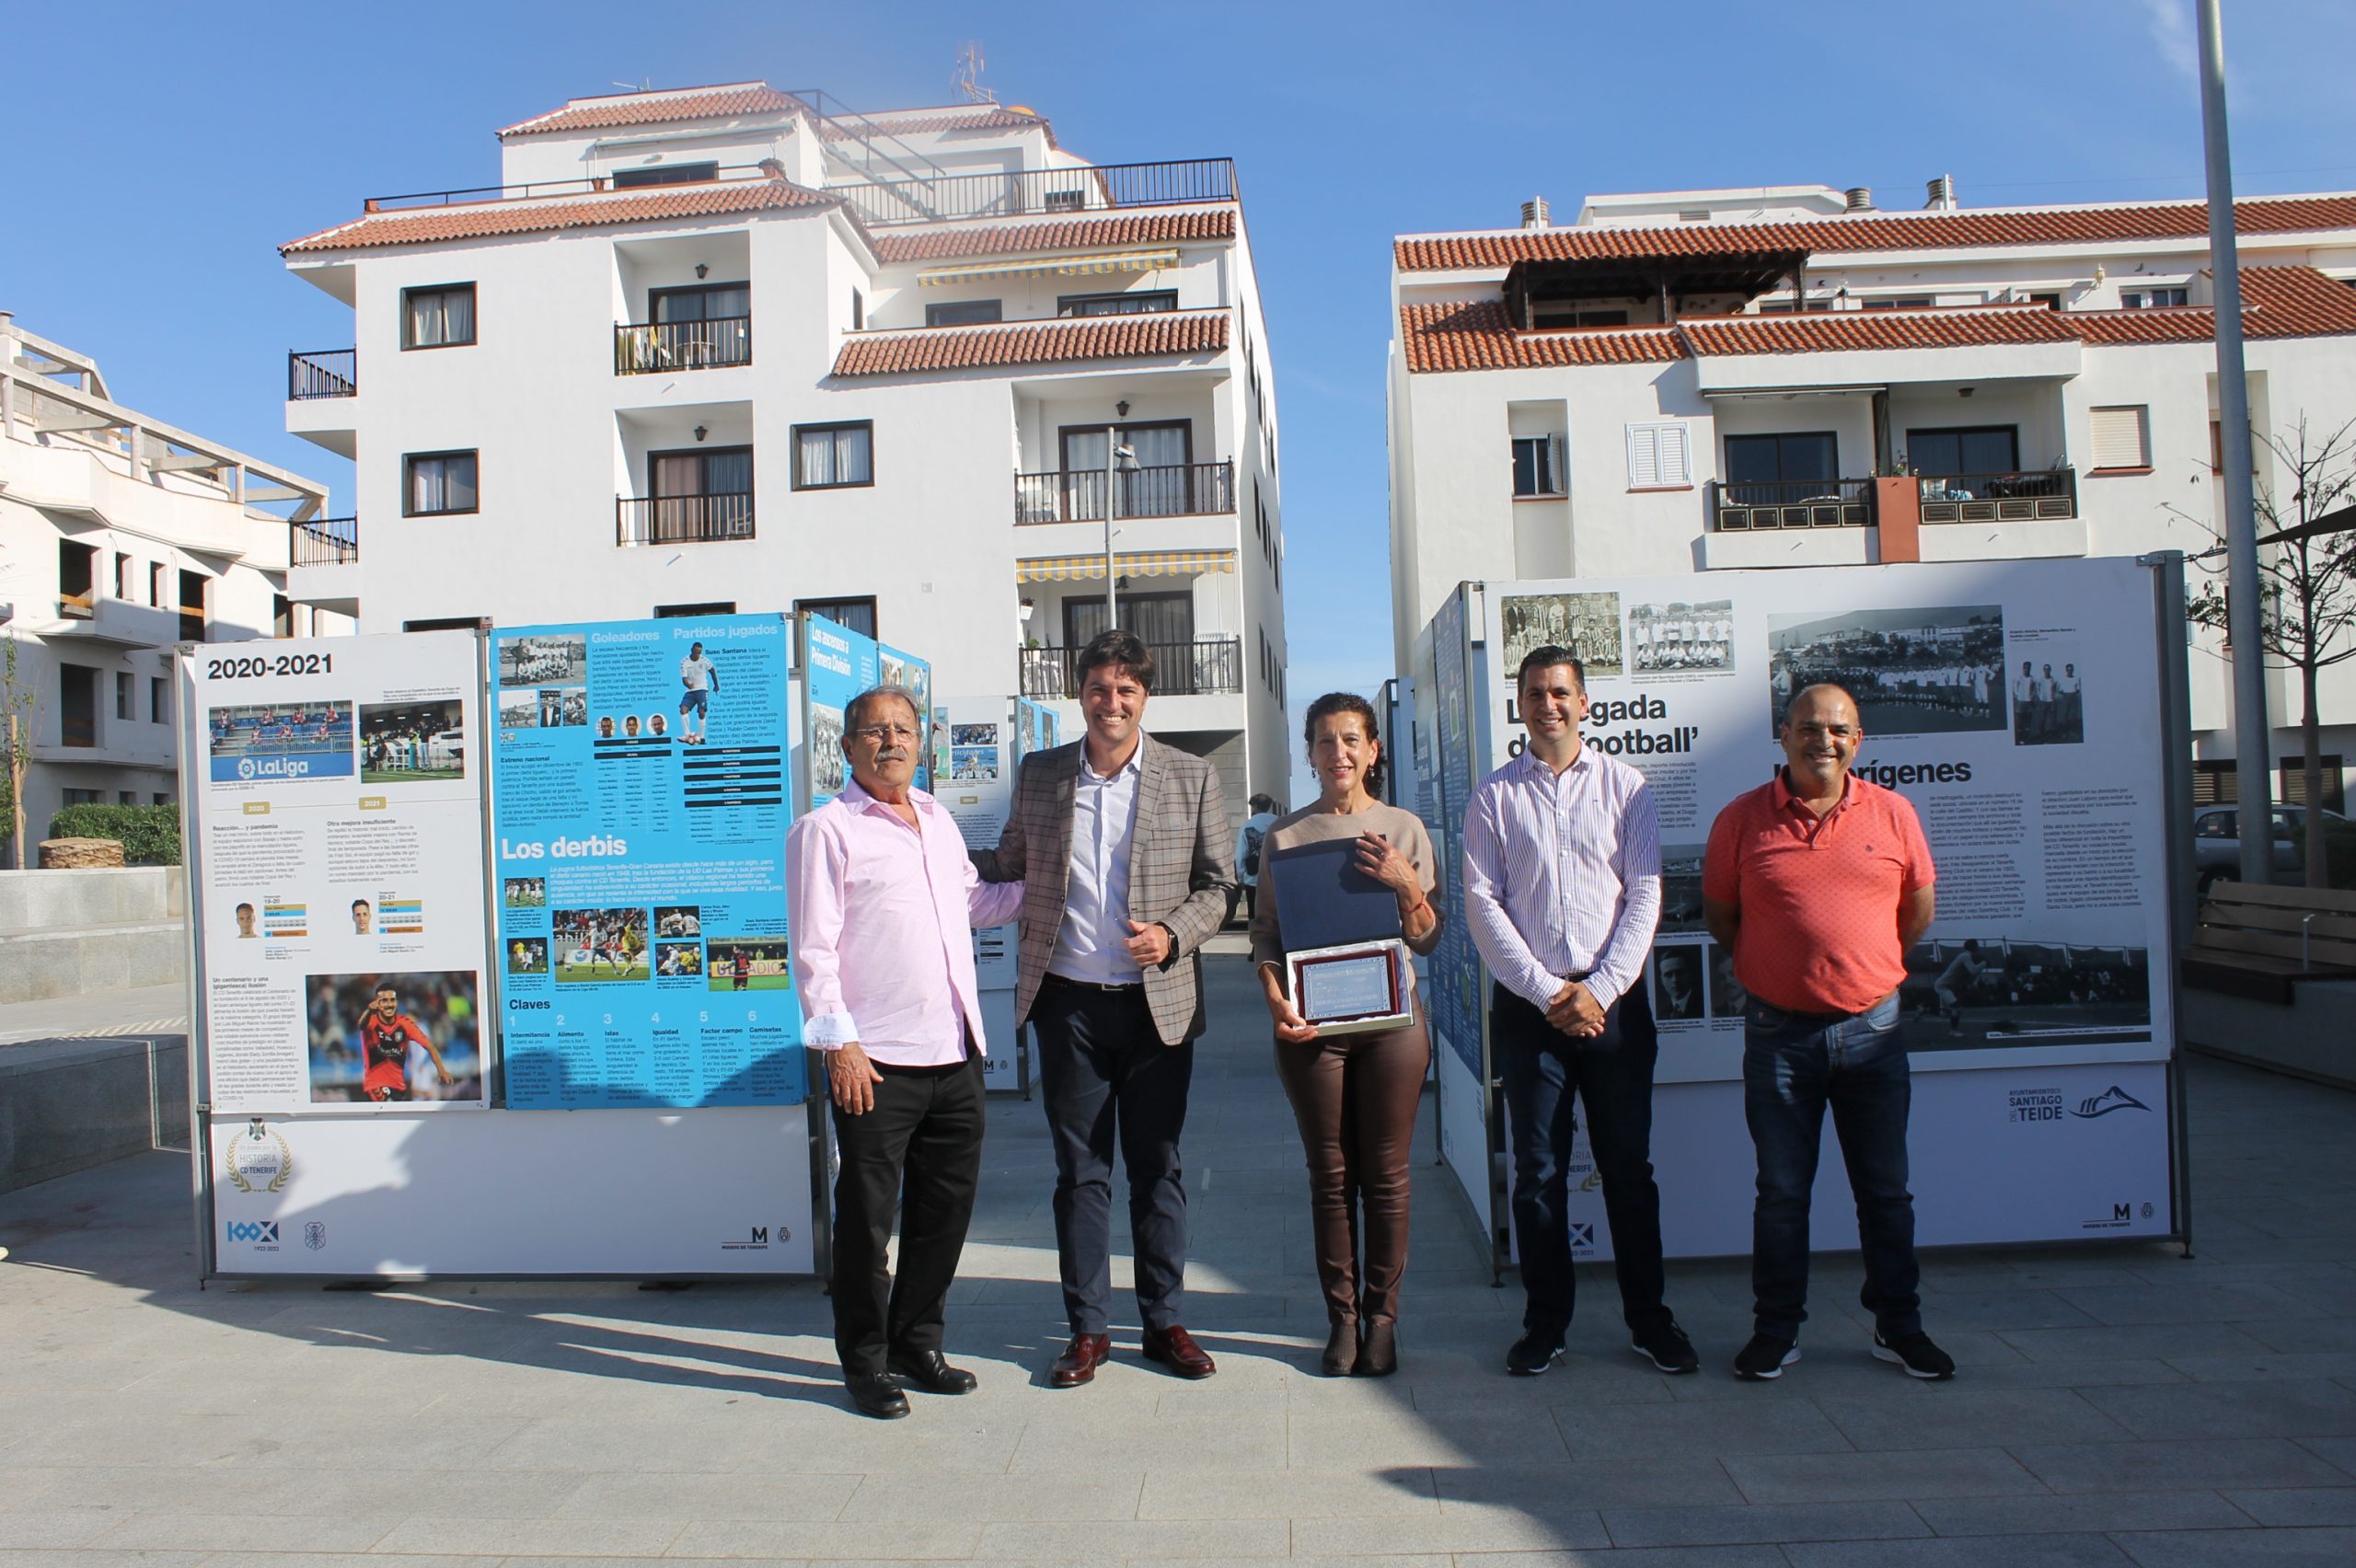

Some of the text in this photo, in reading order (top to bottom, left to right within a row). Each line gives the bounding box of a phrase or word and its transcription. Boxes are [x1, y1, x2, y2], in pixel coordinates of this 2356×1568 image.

[592, 631, 660, 643] Goleadores
[674, 624, 778, 639] Partidos jugados
[812, 622, 822, 643] Los
[208, 653, 332, 680] 2020-2021
[811, 646, 851, 676] Primera División
[1578, 694, 1666, 727] gada
[258, 757, 308, 778] LaLiga
[248, 804, 265, 813] 2020
[502, 835, 628, 859] Los derbis
[509, 998, 550, 1010] Claves
[509, 1016, 515, 1026] 1
[556, 1015, 565, 1026] 2
[604, 1013, 612, 1024] 3
[652, 1012, 660, 1023] 4
[699, 1010, 709, 1021] 5
[748, 1010, 756, 1021] 6
[2009, 1095, 2062, 1106] SANTIAGO
[2018, 1106, 2062, 1121] TEIDE
[240, 1154, 277, 1163] HISTORIA
[2114, 1203, 2130, 1220] M
[752, 1227, 768, 1243] M
